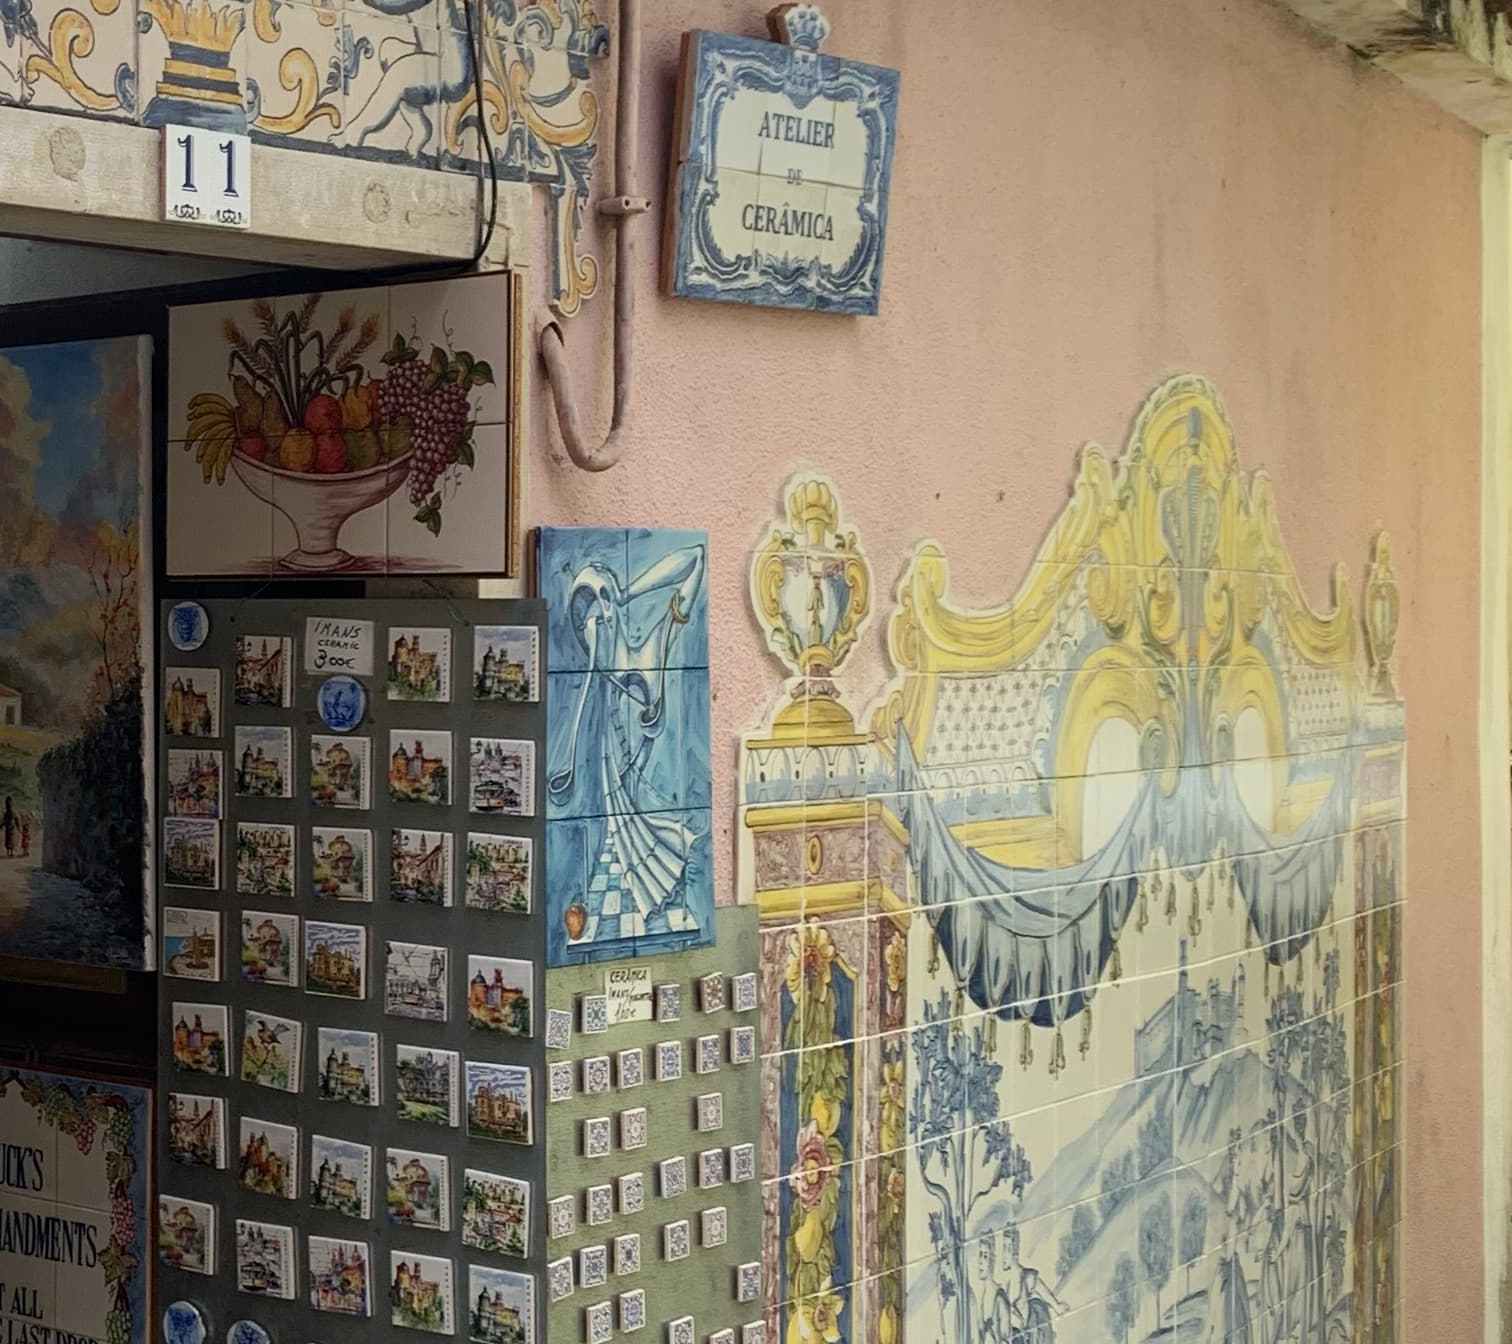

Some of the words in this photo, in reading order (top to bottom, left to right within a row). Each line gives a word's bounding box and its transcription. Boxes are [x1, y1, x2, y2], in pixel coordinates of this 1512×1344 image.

[757, 111, 835, 149] ATELIER
[177, 134, 239, 197] 11
[786, 167, 803, 186] DE
[741, 201, 834, 241] CERÂMICA
[11, 1287, 43, 1319] ALL
